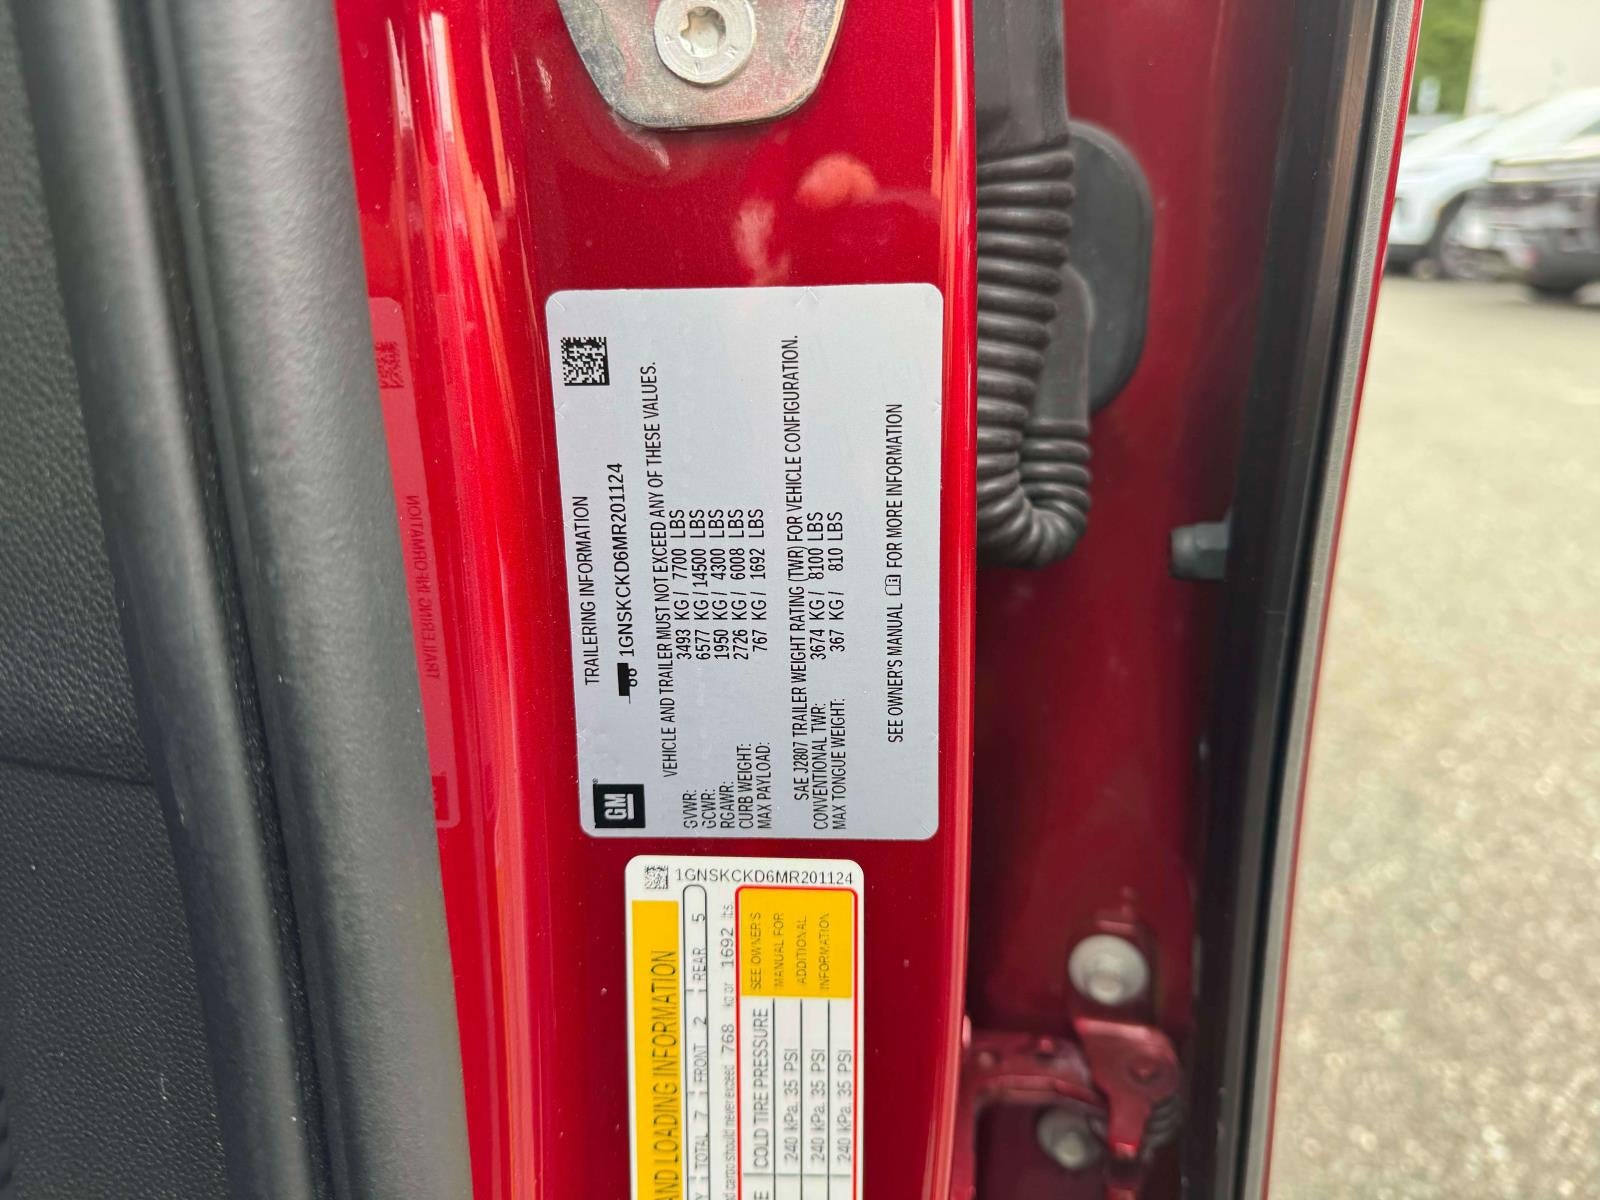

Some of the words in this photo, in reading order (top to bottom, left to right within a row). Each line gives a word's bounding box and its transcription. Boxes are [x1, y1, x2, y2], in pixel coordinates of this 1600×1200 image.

[640, 362, 659, 419] VALUES.
[781, 336, 801, 452] CONFIGURATION.
[644, 424, 662, 466] THESE
[886, 404, 902, 496] INFORMATION
[646, 470, 664, 488] OF
[784, 456, 802, 512] VEHICLE
[648, 492, 665, 518] ANY
[886, 500, 903, 538] MORE
[668, 509, 686, 538] LBS
[688, 509, 706, 538] LBS
[708, 509, 725, 538] LBS
[727, 509, 744, 538] LBS
[748, 509, 764, 538] LBS
[786, 516, 803, 542] FOR
[806, 512, 824, 541] LBS
[826, 512, 843, 541] LBS
[572, 496, 595, 596] INFORMATION
[606, 463, 635, 657] 1GNSKCKD6MR201124
[650, 522, 668, 572] EXCEED
[827, 548, 844, 572] 810
[886, 542, 903, 568] FOR
[670, 548, 688, 580] 7700
[690, 548, 708, 587] 14500
[709, 548, 727, 580] 4300
[728, 548, 746, 580] 6008
[749, 548, 766, 580] 1692
[786, 546, 809, 582] (TWR)
[807, 547, 824, 580] 8100
[653, 576, 670, 602] NOT
[654, 606, 672, 640] MUST
[788, 586, 806, 631] RATING
[580, 601, 600, 686] TRAILERING
[675, 629, 692, 660] 3493
[694, 629, 711, 660] 6577
[713, 629, 730, 660] 1950
[732, 629, 749, 660] 2726
[752, 629, 768, 652] 767
[809, 629, 826, 660] 3674
[829, 629, 845, 652] 367
[886, 603, 903, 656] MANUAL
[656, 643, 674, 695] TRAILER
[790, 635, 806, 684] WEIGHT
[887, 659, 903, 716] OWNER'S
[659, 698, 675, 723] AND
[791, 687, 808, 738] TRAILER
[810, 703, 826, 734] TWR:
[830, 698, 846, 748] WEIGHT:
[887, 719, 904, 743] SEE
[660, 727, 678, 778] VEHICLE
[736, 744, 753, 793] WEIGHT:
[792, 741, 809, 774] J2807
[755, 742, 772, 800] PAYLOAD:
[811, 736, 829, 830] CONVENTIONAL
[830, 751, 846, 801] TONGUE
[793, 777, 810, 800] SAE
[682, 790, 698, 829] GVWR:
[700, 789, 717, 829] GCWR:
[719, 781, 735, 829] RGAWR:
[738, 796, 754, 829] CURB
[757, 804, 772, 829] MAX
[832, 805, 846, 830] MAX
[676, 867, 853, 886] 1GNSKCKD6MR201124
[691, 913, 706, 923] 5
[774, 913, 784, 936] FOR
[692, 947, 706, 981] REAR
[720, 928, 734, 968] 1692
[774, 940, 784, 987] MANUAL
[796, 917, 807, 985] ADDITIONAL
[818, 913, 830, 991] INFORMATION
[751, 968, 761, 990] SEE
[650, 950, 677, 1076] INFORMATION
[693, 1015, 707, 1026] 2
[722, 1024, 734, 1053] 768
[752, 1009, 769, 1088] PRESSURE
[693, 1043, 707, 1084] FRONT
[784, 1049, 798, 1072] PSI
[811, 1049, 824, 1073] PSI
[838, 1050, 851, 1073] PSI
[784, 1080, 798, 1097] 35
[811, 1080, 824, 1097] 35
[838, 1080, 851, 1097] 35
[652, 1082, 678, 1163] LOADING
[694, 1110, 708, 1119] 7
[753, 1092, 769, 1123] TIRE
[694, 1132, 708, 1169] TOTAL
[753, 1130, 769, 1169] COLD
[784, 1137, 798, 1163] 240
[811, 1137, 825, 1163] 240
[838, 1137, 852, 1163] 240
